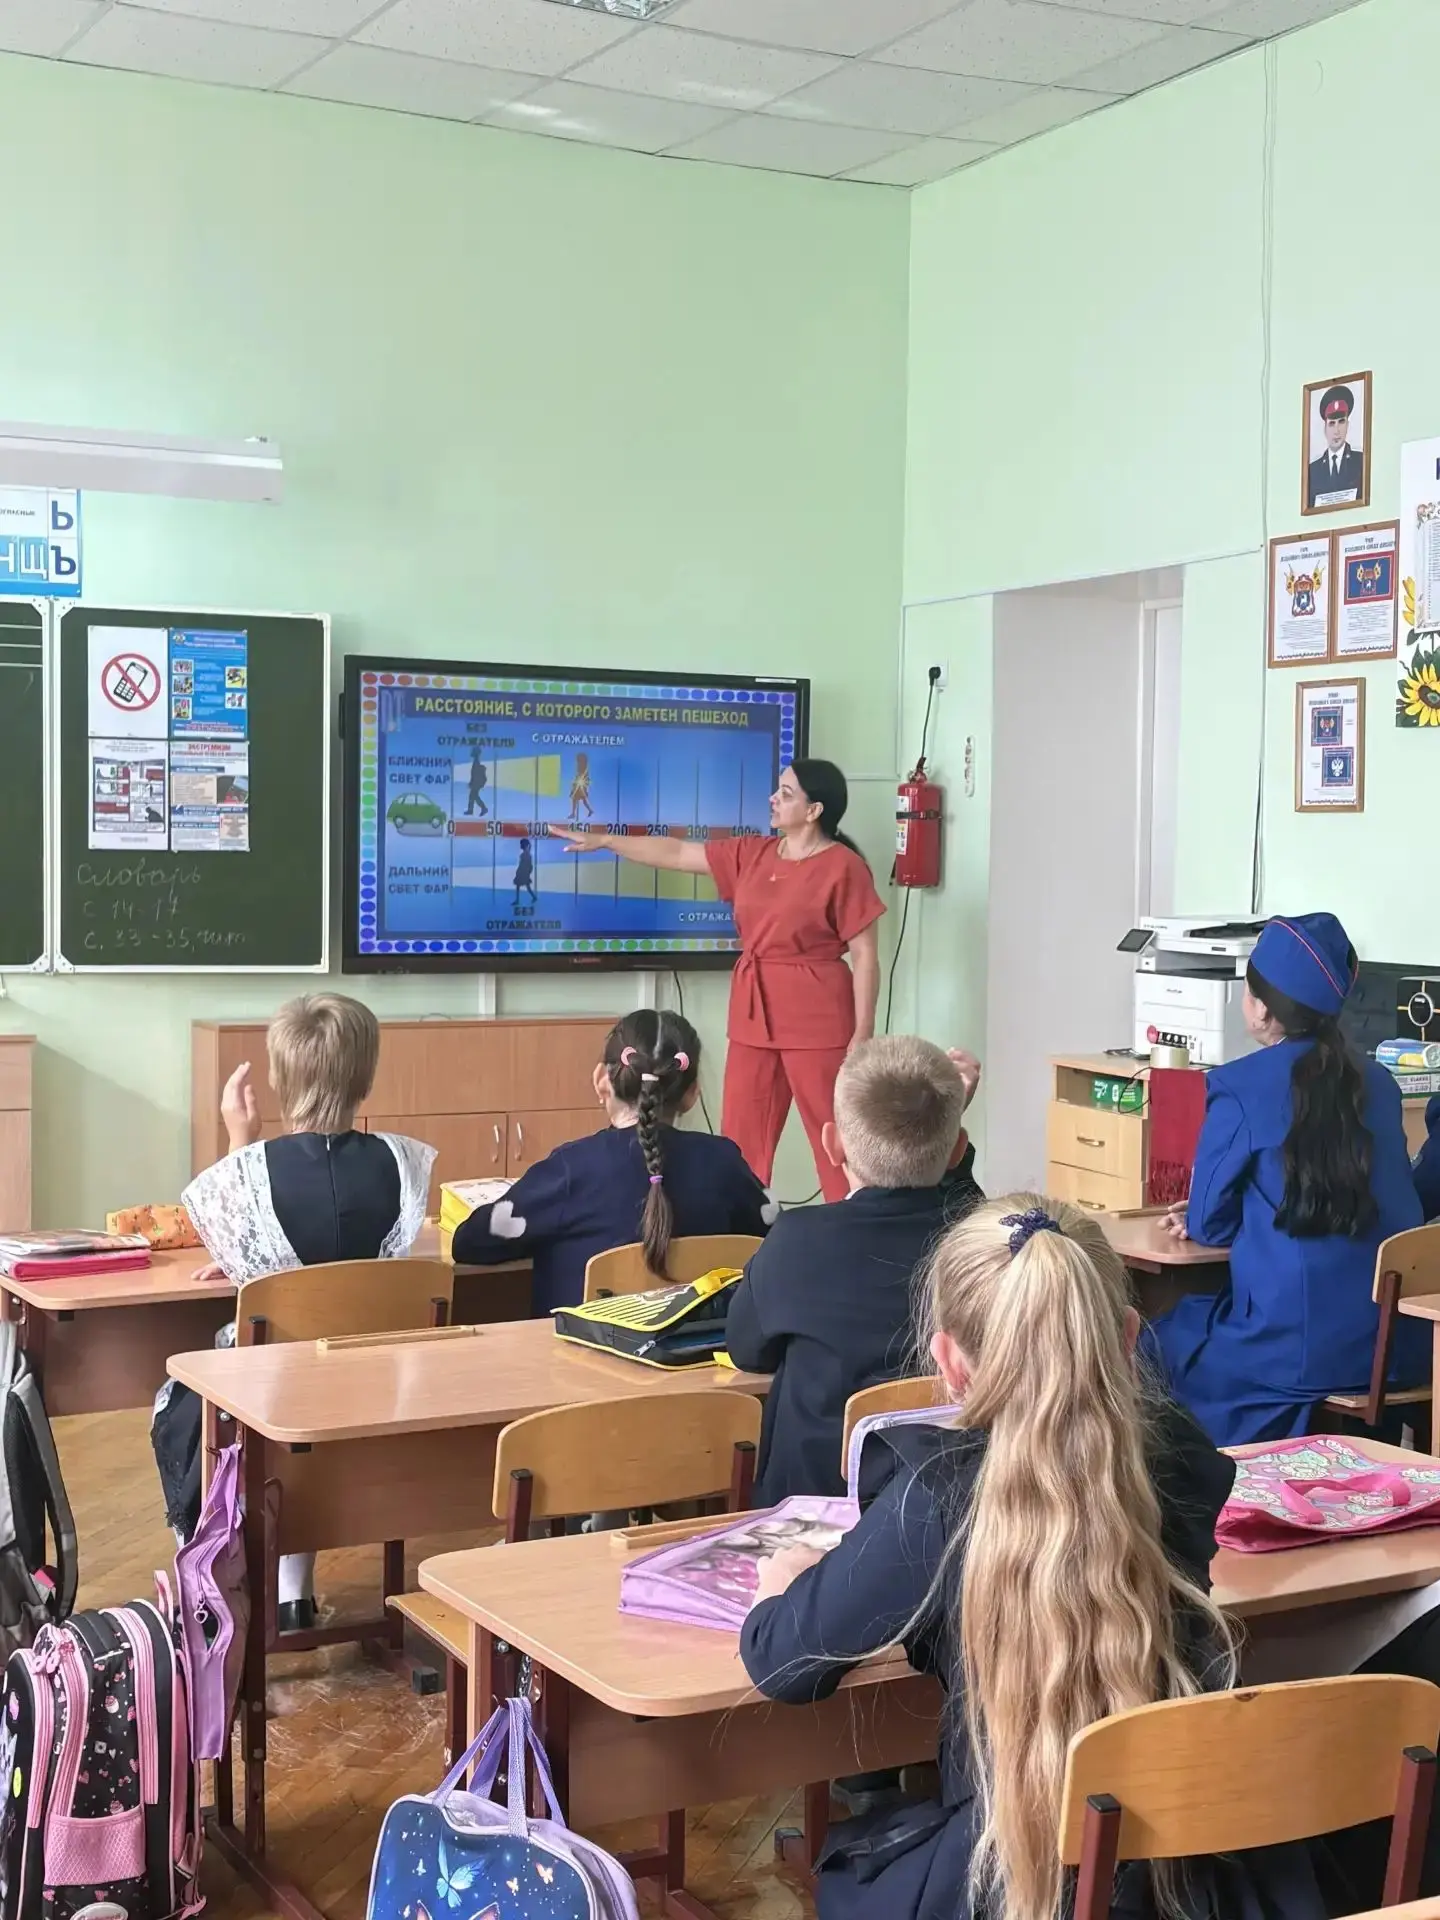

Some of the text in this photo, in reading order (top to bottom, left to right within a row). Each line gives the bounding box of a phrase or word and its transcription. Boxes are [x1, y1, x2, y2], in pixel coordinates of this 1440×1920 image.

[51, 500, 74, 530] Ь
[20, 542, 48, 580] Щ
[50, 545, 76, 575] Ъ
[415, 697, 749, 727] РАССТОЯНИЕ, С КОТОРОГО ЗАМЕТЕН ПЕШЕХОД
[532, 733, 625, 746] С ОТРАЖАТЕЛЕМ
[388, 755, 452, 767] БЛИЖНИЙ
[389, 773, 450, 785] СВЕТ ФАР
[447, 822, 455, 834] 0
[486, 822, 503, 836] 50
[527, 822, 549, 837] 100
[606, 823, 629, 836] 200
[647, 824, 669, 837] 250
[388, 865, 449, 878] ДАЛЬНИЙ
[388, 884, 449, 894] СВЕТ ФАР
[678, 912, 736, 922] С ОТРАЖАТ
